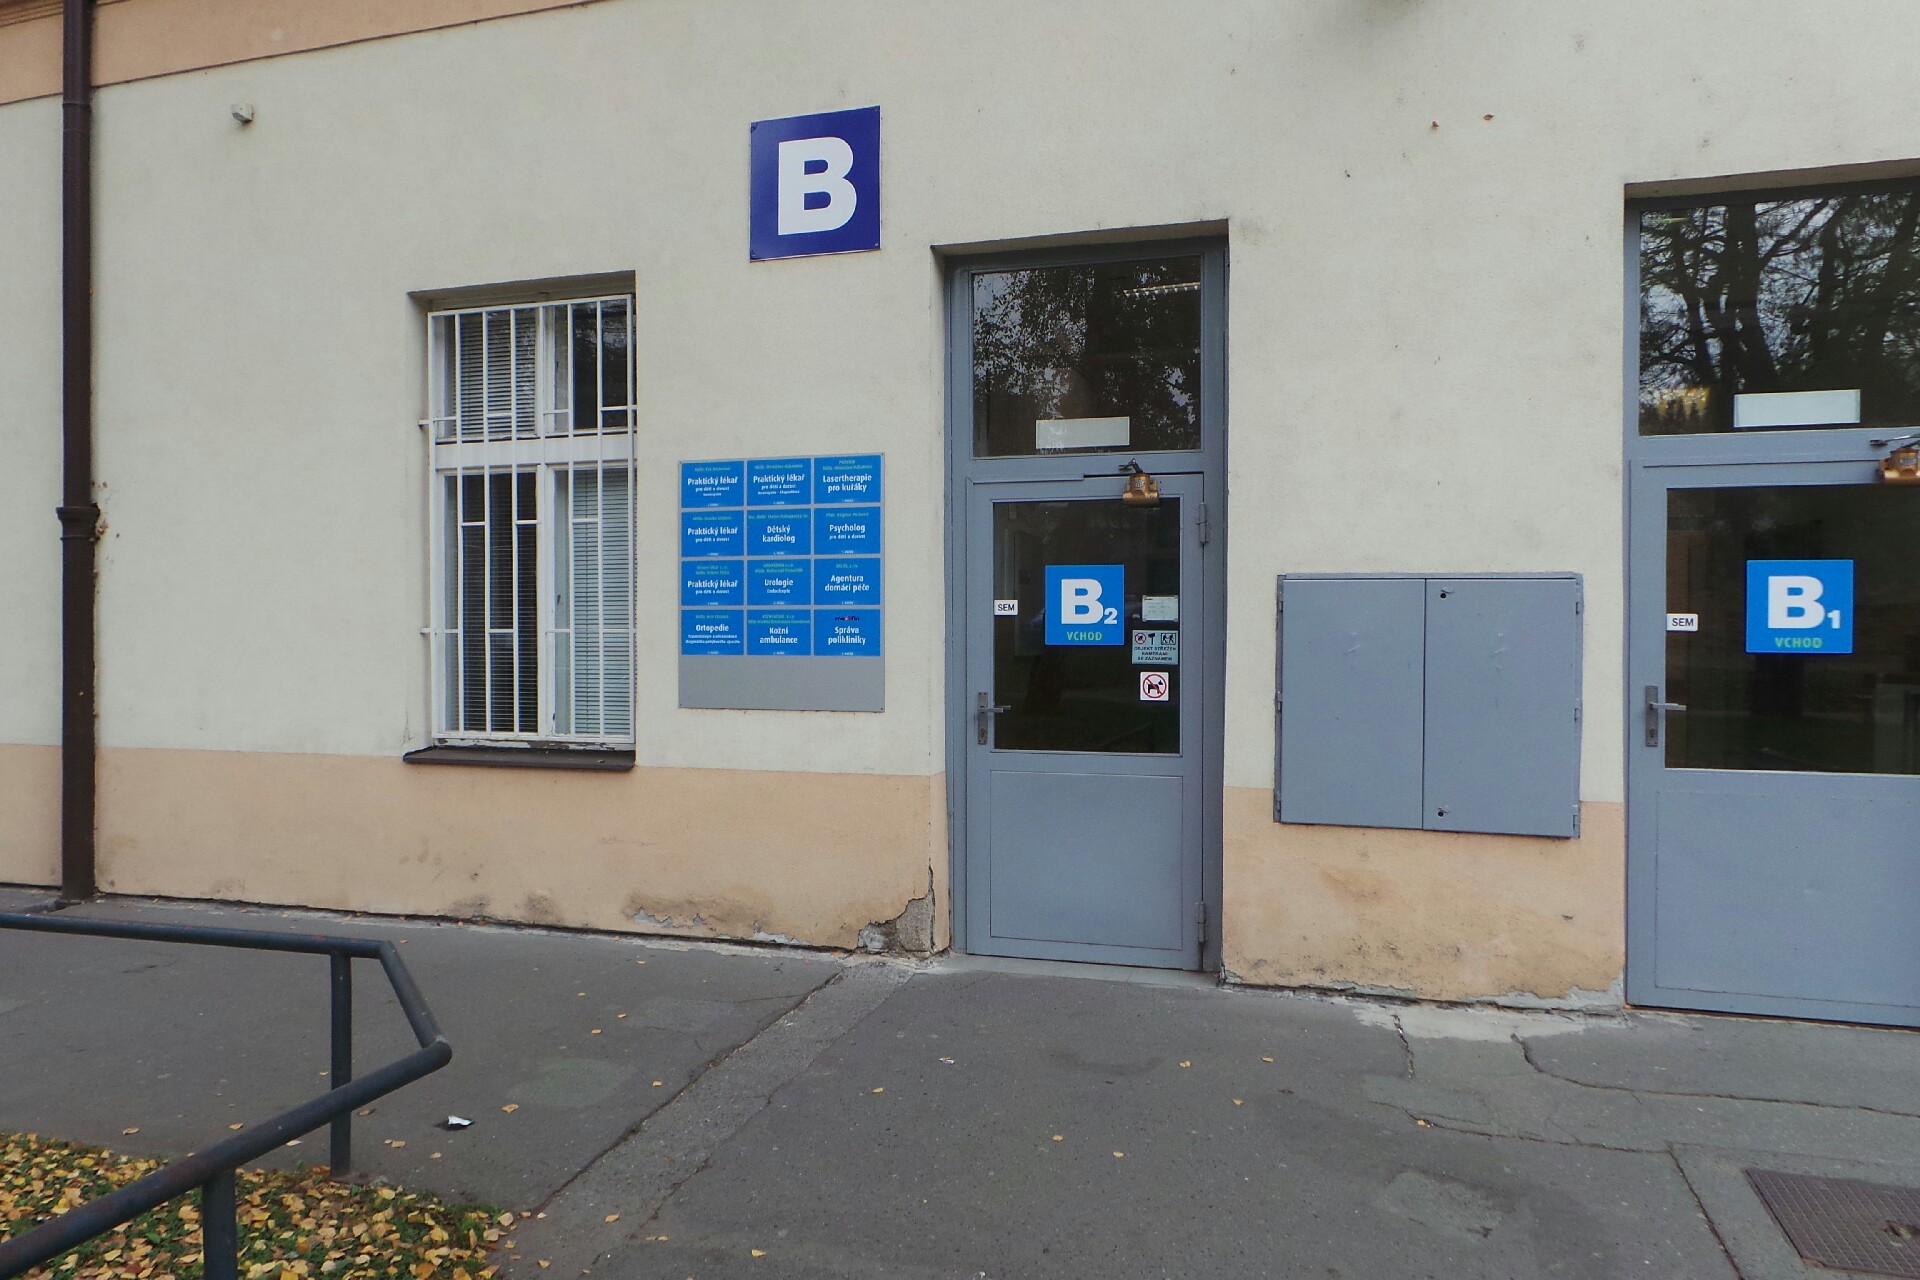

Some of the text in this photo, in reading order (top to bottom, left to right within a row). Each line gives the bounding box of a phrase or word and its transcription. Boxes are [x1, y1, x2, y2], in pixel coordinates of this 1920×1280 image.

[778, 136, 857, 235] B
[688, 476, 738, 485] Praktický lékař
[753, 473, 805, 483] Praktický lékař
[823, 473, 872, 483] Lasertherapie
[828, 483, 867, 493] pro kuřáky
[688, 526, 738, 536] Praktický lékař
[767, 525, 790, 534] Dětský
[829, 523, 865, 533] Psycholog
[763, 534, 795, 543] kardiolog
[688, 579, 738, 589] Praktický lékař
[765, 578, 793, 588] Urologie
[831, 575, 864, 583] Agentura
[853, 584, 870, 593] péče
[997, 603, 1015, 612] SEM
[1671, 618, 1694, 627] SEM
[696, 624, 729, 633] Ortopedie
[835, 626, 859, 635] Správa
[760, 635, 798, 643] ambulance
[828, 635, 866, 645] polikliniky
[1067, 631, 1103, 641] VCHOD
[1775, 637, 1823, 648] VCHOD
